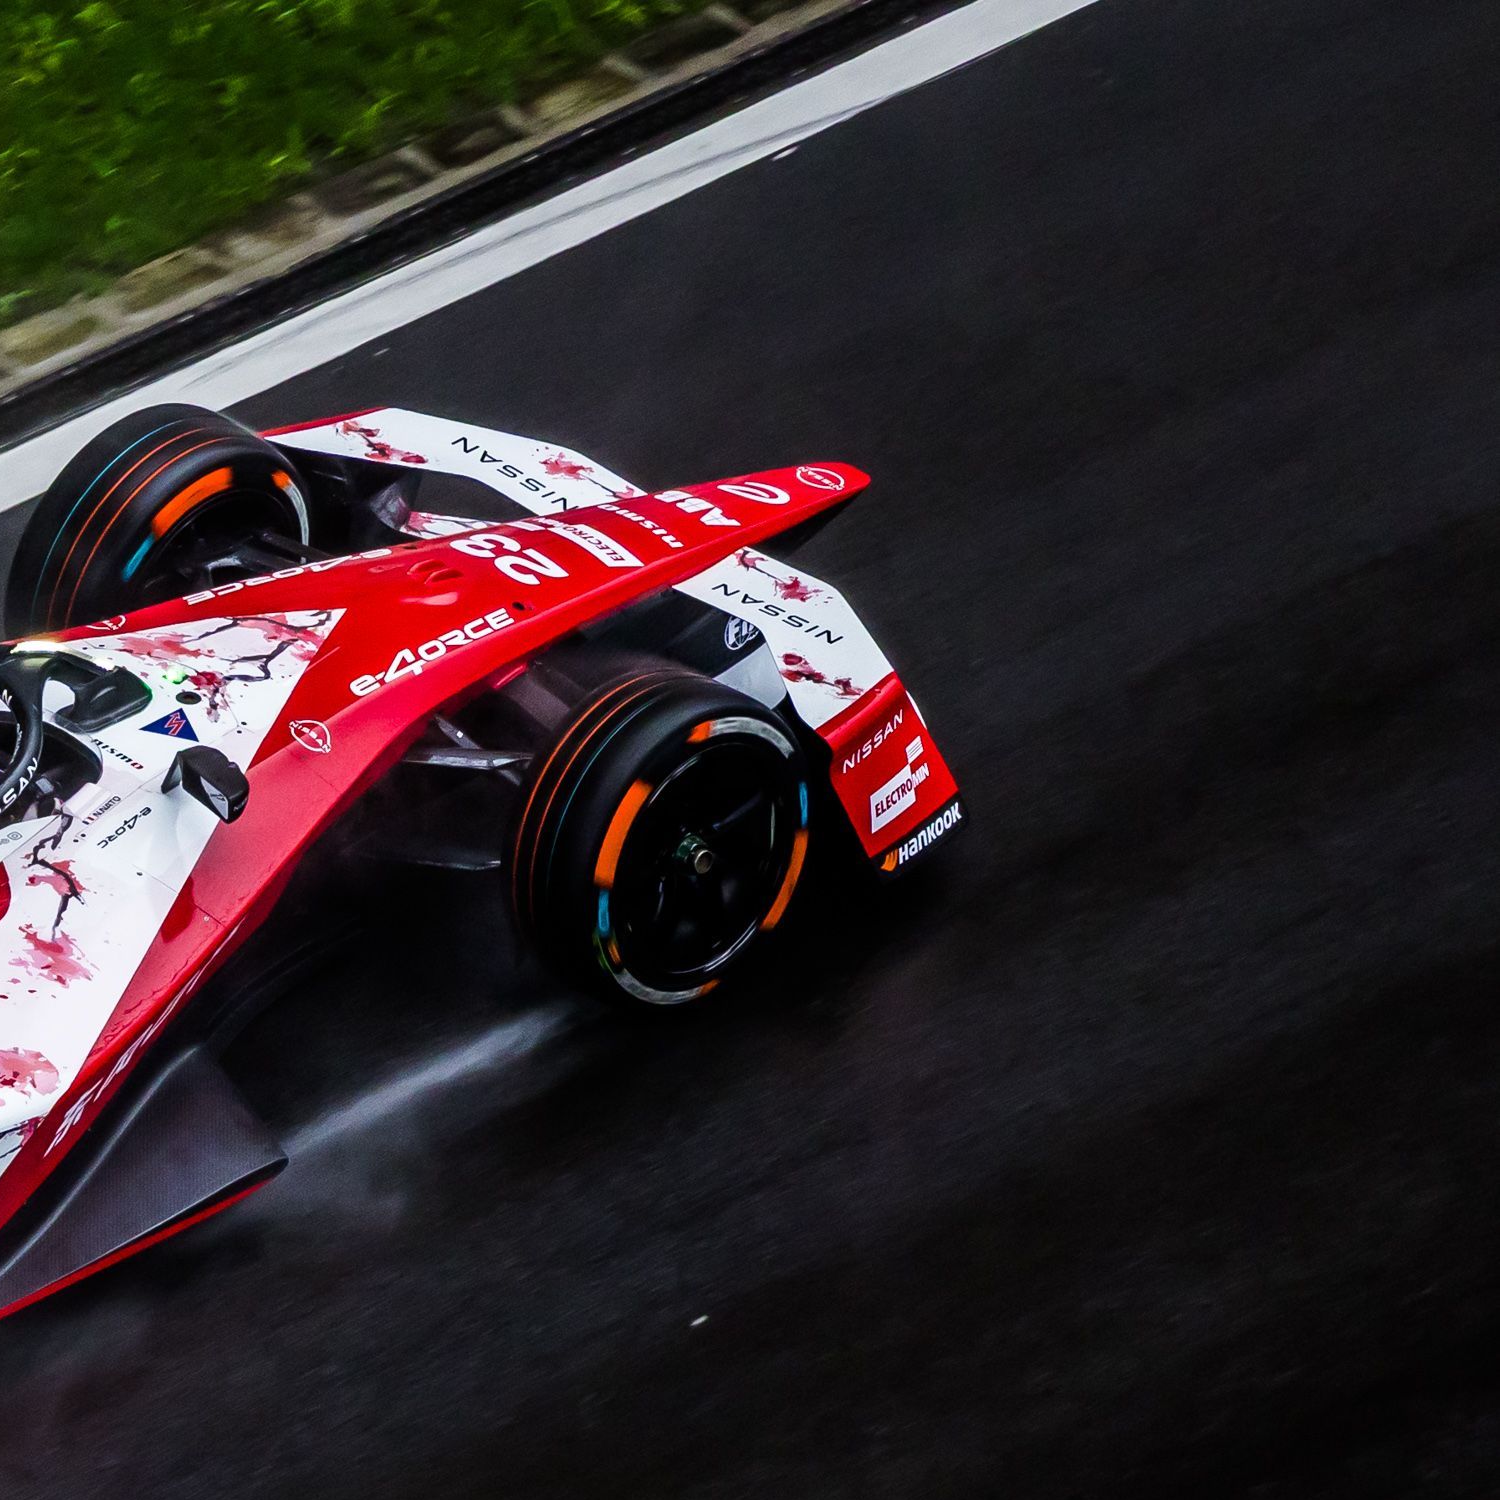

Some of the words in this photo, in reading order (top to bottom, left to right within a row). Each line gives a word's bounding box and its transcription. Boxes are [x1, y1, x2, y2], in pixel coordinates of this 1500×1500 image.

[450, 435, 580, 512] NISSAN
[597, 503, 685, 549] nismo
[654, 489, 742, 527] ABB
[449, 533, 570, 586] 23
[711, 583, 844, 645] NISSAN
[349, 607, 515, 697] e-4ORCE
[90, 738, 145, 771] nismo
[841, 708, 905, 775] NISSAN
[874, 762, 931, 819] ELECTROMIN
